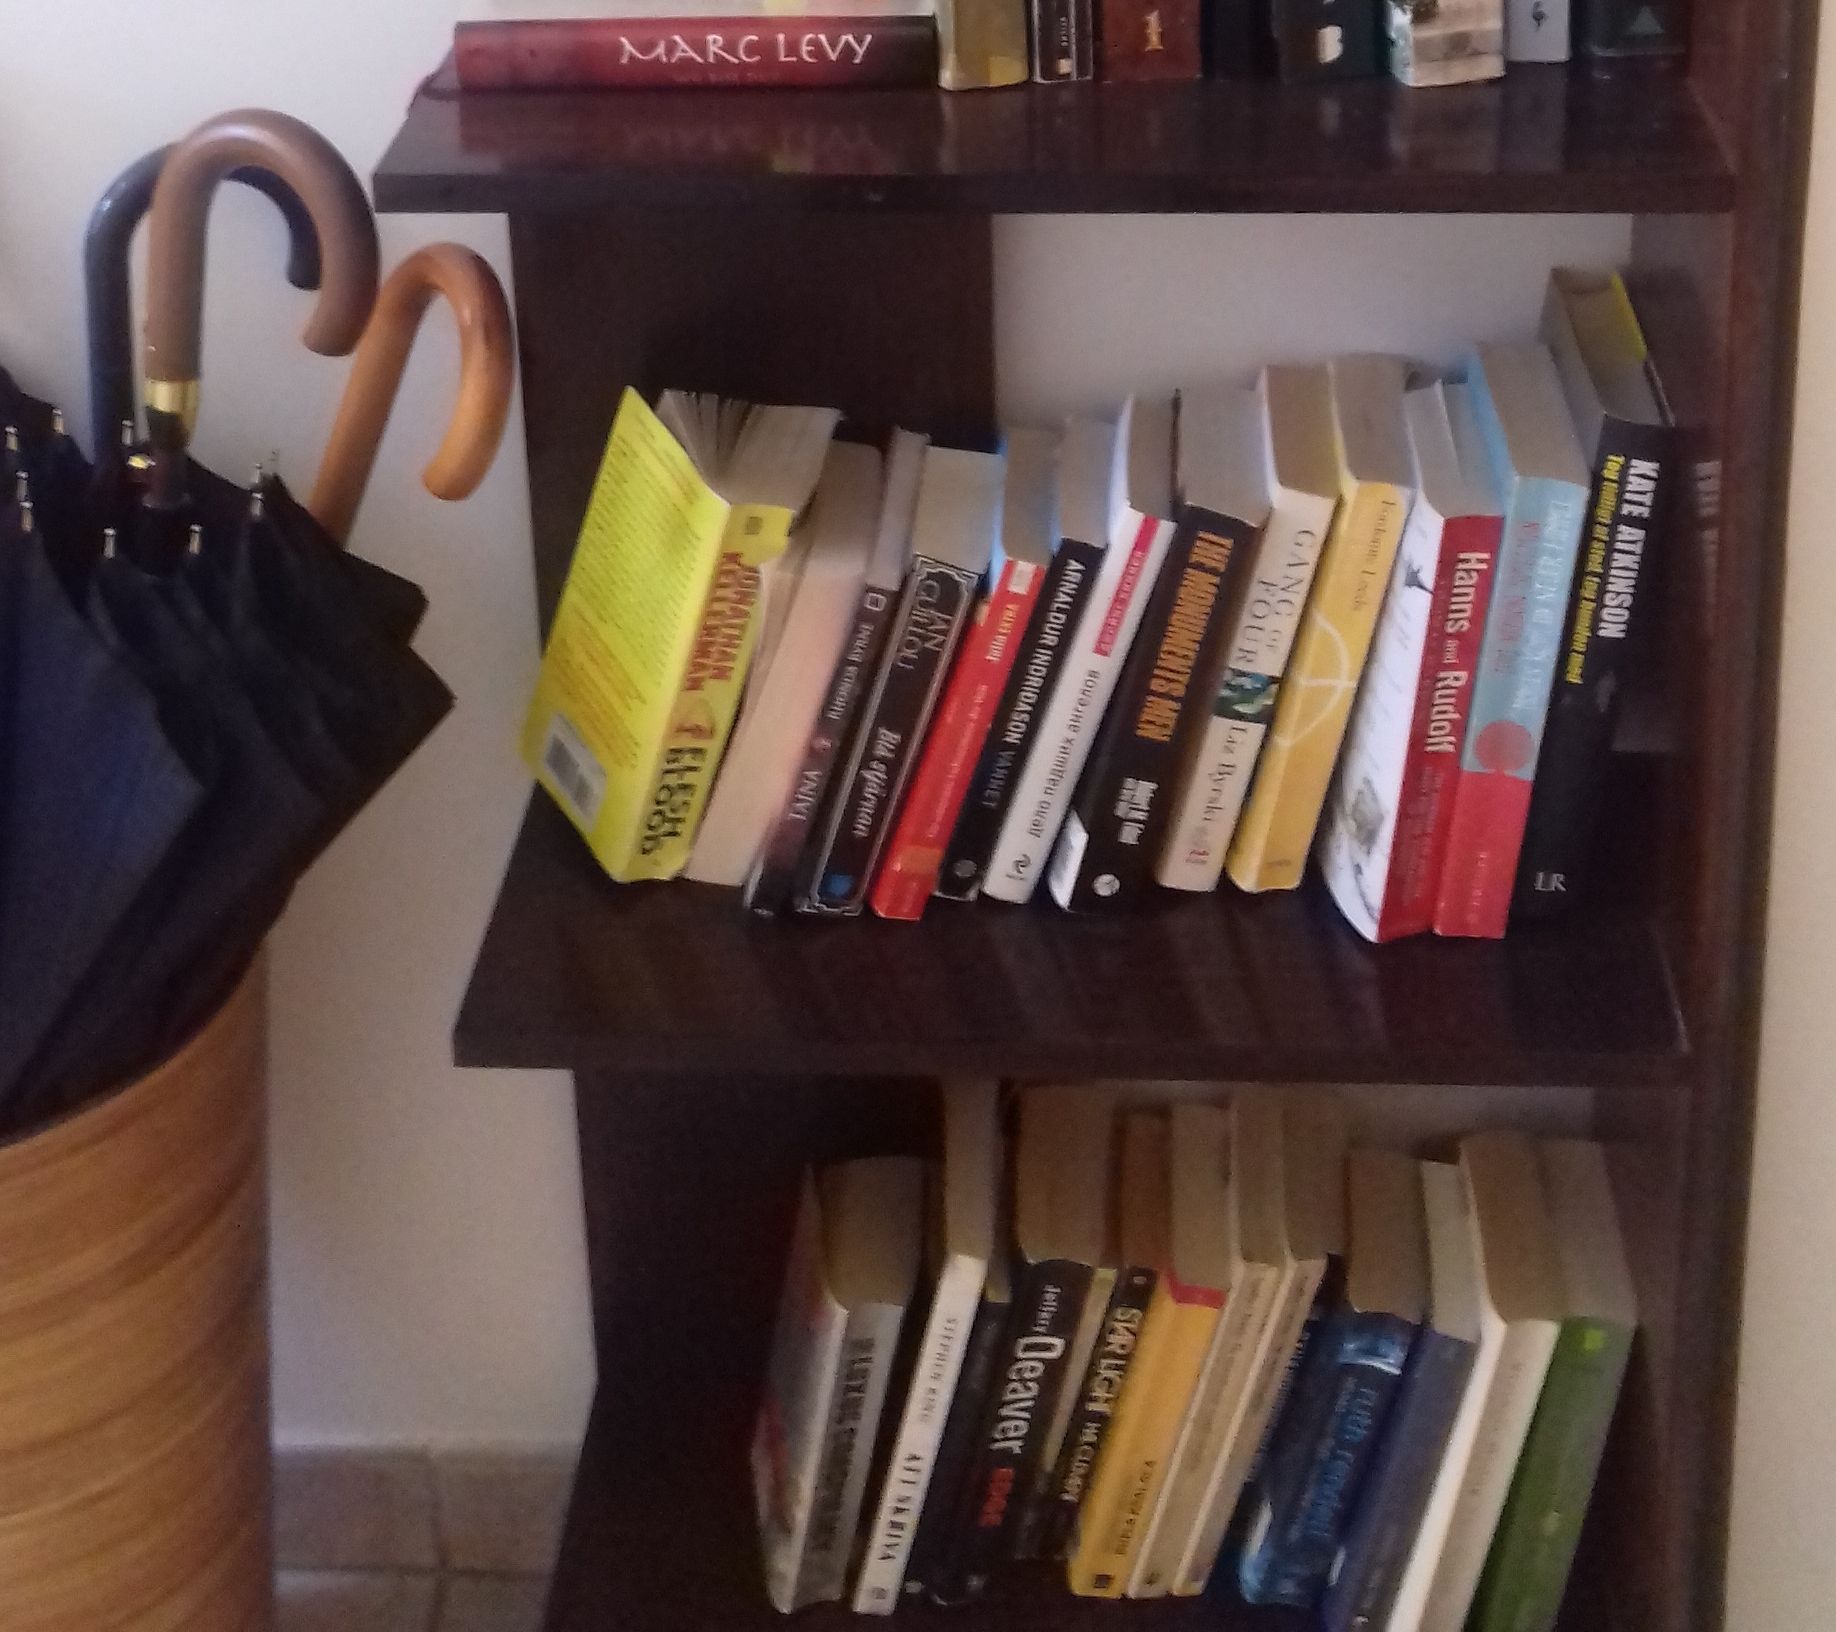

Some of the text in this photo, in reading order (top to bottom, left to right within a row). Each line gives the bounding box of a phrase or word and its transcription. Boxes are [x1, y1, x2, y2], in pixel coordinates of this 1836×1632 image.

[618, 31, 874, 65] MARC LEVY
[1189, 529, 1235, 573] THE
[1276, 529, 1316, 620] GANG
[1597, 458, 1661, 640] KATE ATKINSON
[922, 612, 952, 653] JAN
[1040, 558, 1086, 646] ARNALDUR
[1237, 578, 1279, 667] FOUR
[1445, 551, 1492, 635] Hanns
[1135, 695, 1183, 744] MEN
[1424, 670, 1469, 754] Rudolf
[988, 1335, 1066, 1455] Deaver
